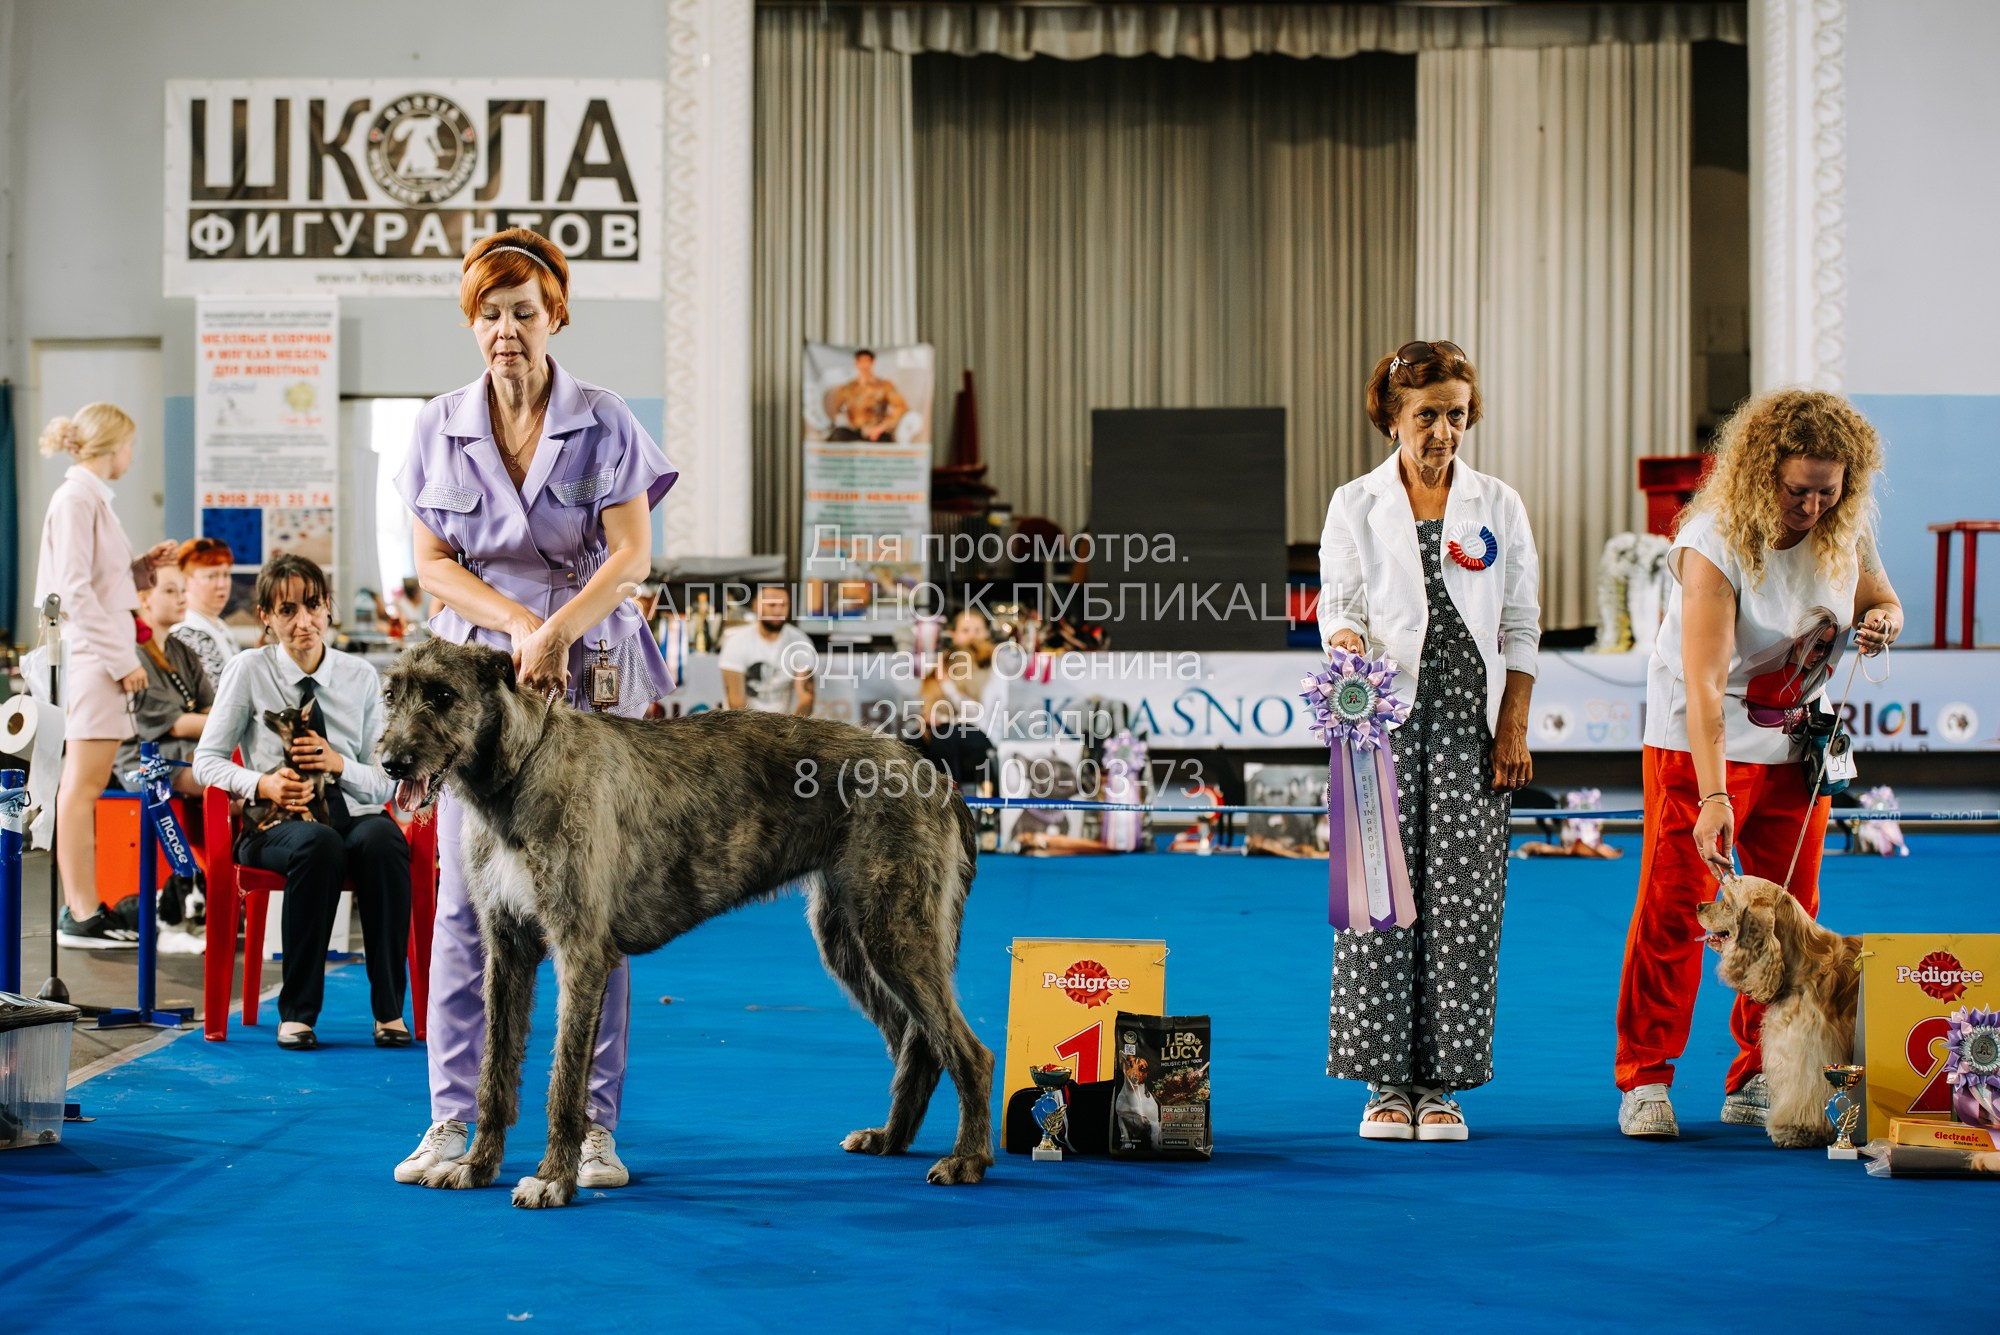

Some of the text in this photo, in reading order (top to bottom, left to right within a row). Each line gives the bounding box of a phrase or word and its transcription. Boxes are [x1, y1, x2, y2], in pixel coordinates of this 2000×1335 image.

[190, 92, 639, 208] ШКОЛА
[1043, 687, 1316, 738] KASNO
[1042, 972, 1131, 992] Pedigree
[1896, 965, 1985, 986] Pedigree
[1053, 1020, 1103, 1084] 1
[1161, 1045, 1204, 1060] LUCY
[1905, 1016, 1952, 1114] 2
[1934, 1131, 1980, 1143] Electronic
